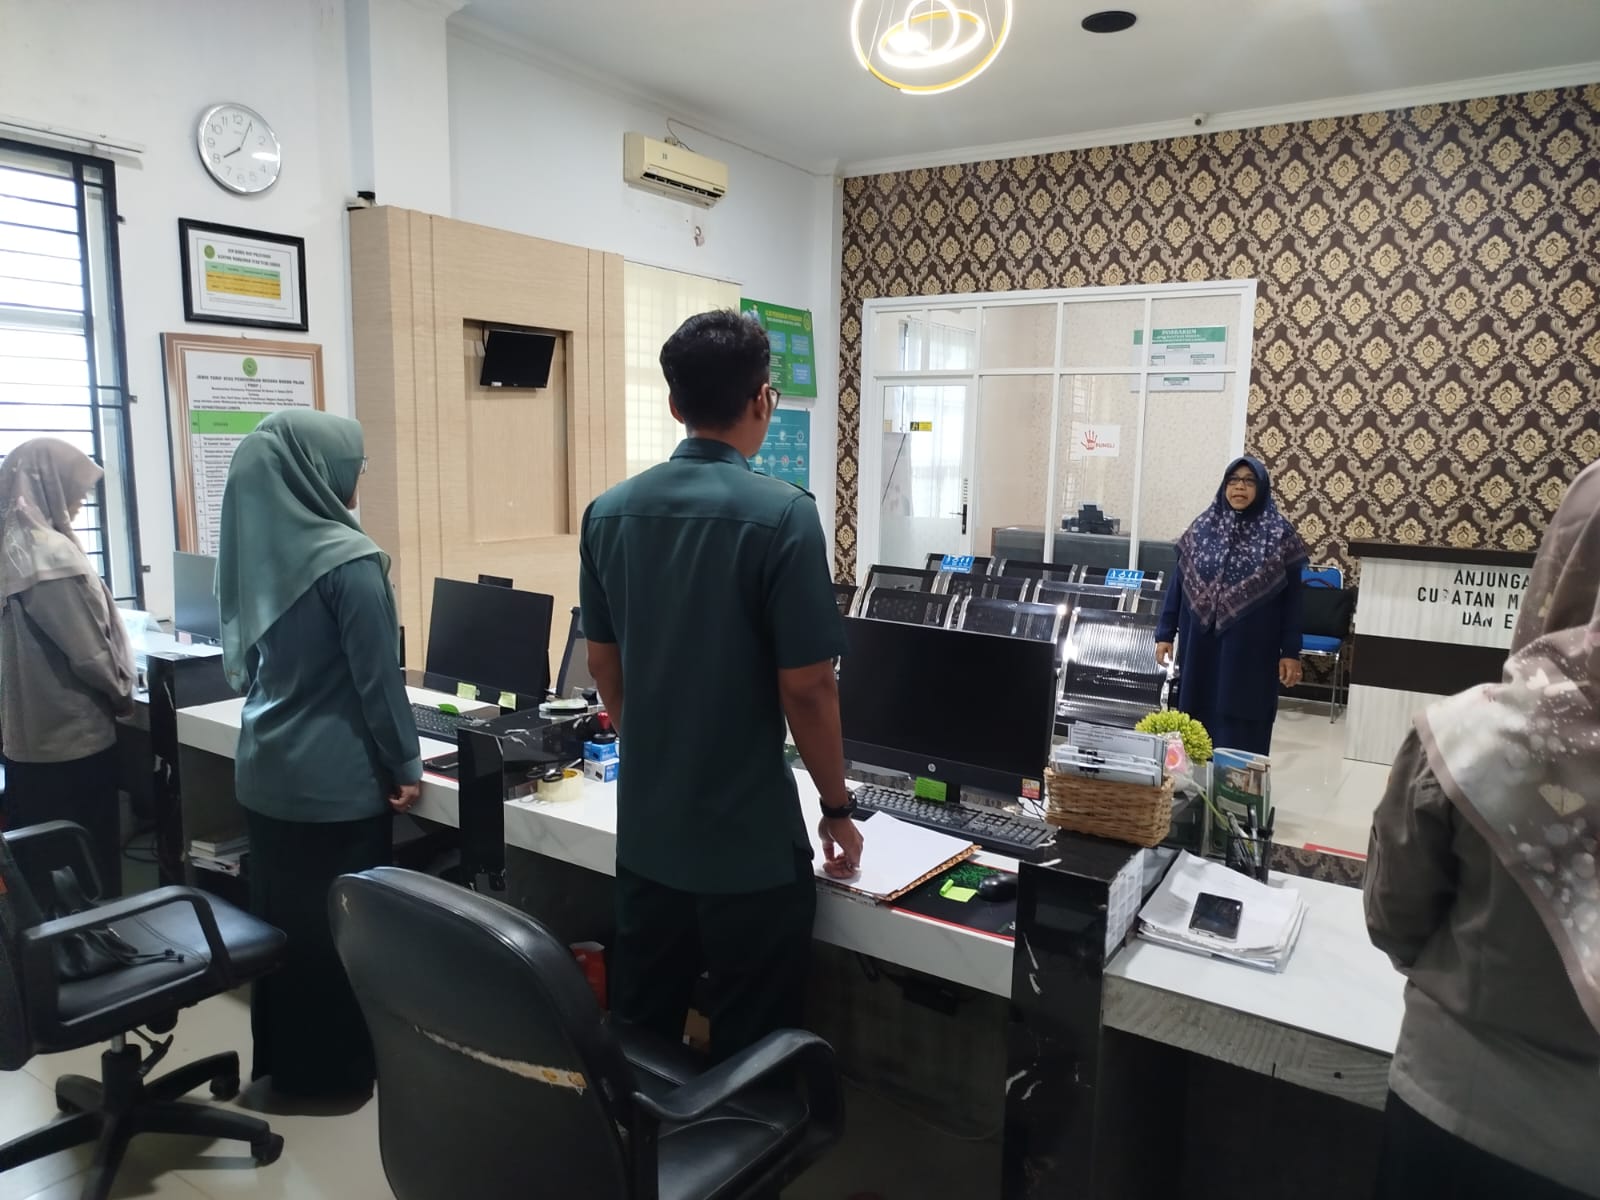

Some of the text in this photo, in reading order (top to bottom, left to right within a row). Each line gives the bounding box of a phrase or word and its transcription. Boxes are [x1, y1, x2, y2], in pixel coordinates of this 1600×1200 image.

[232, 113, 243, 124] 12
[208, 120, 223, 135] 10
[207, 137, 215, 147] 9
[258, 135, 266, 145] 2
[213, 153, 220, 163] 8
[226, 165, 232, 176] 7
[1453, 569, 1530, 590] ANJUNGA
[1417, 587, 1494, 608] CUATAN
